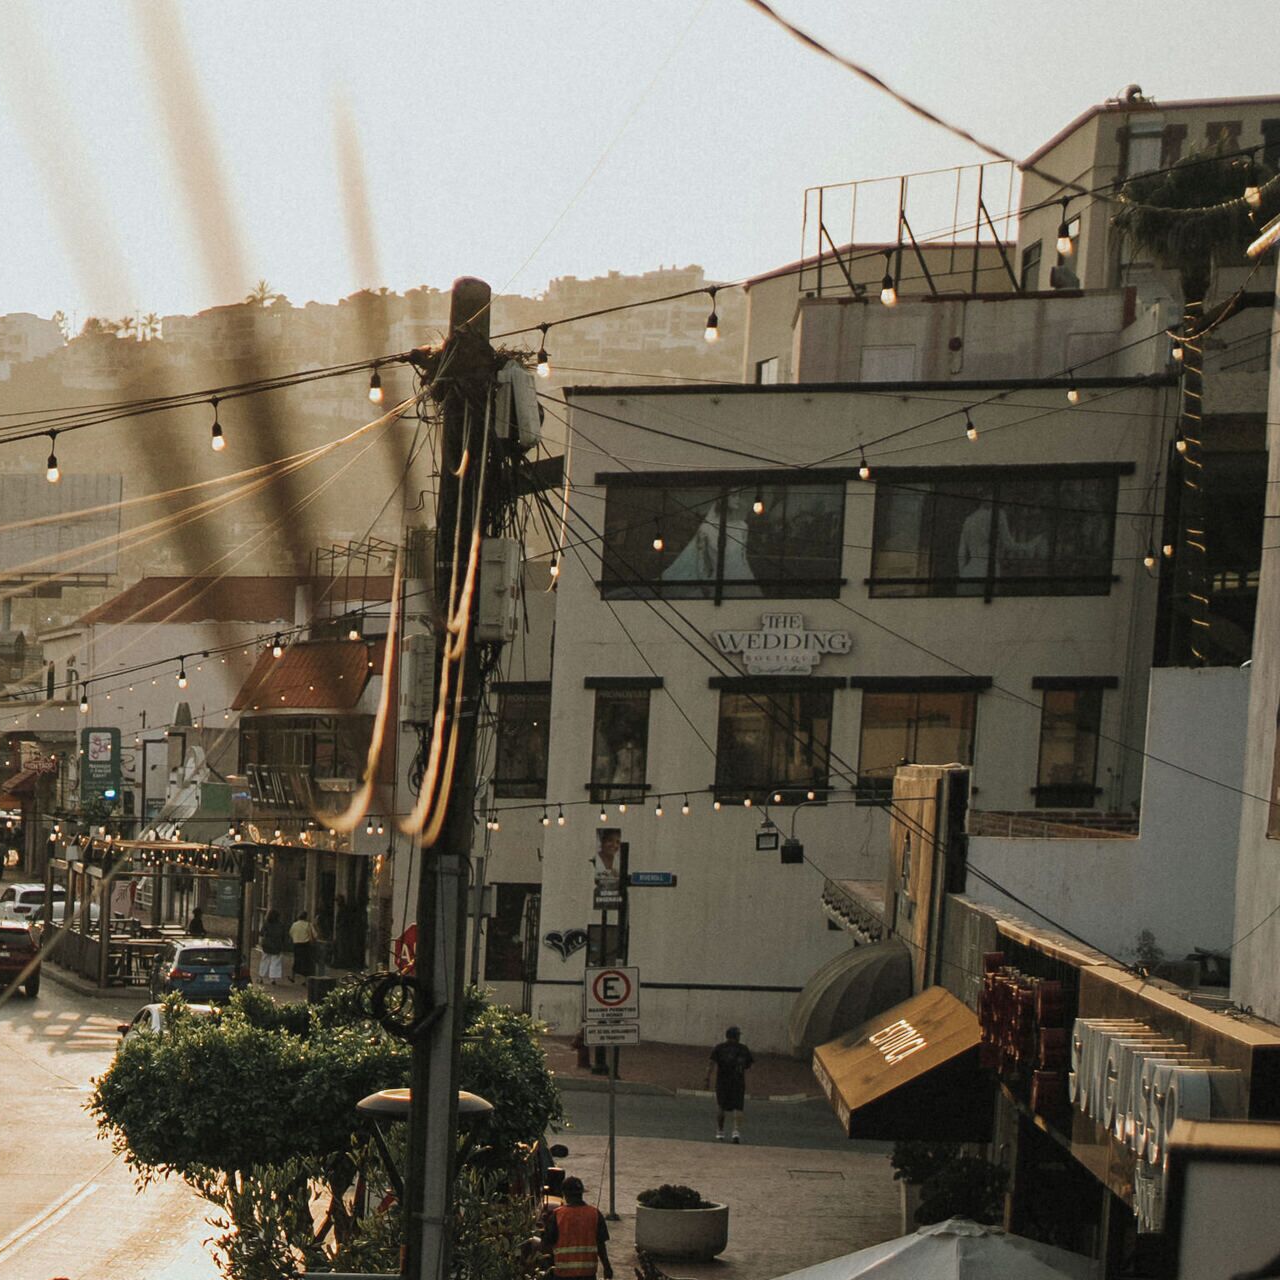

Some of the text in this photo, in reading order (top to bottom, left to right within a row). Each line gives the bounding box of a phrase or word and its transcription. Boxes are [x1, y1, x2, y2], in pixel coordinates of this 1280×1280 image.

[766, 615, 801, 629] THE
[717, 633, 848, 650] WEDDING
[745, 655, 818, 664] BOUTIQUE
[603, 976, 620, 1000] E
